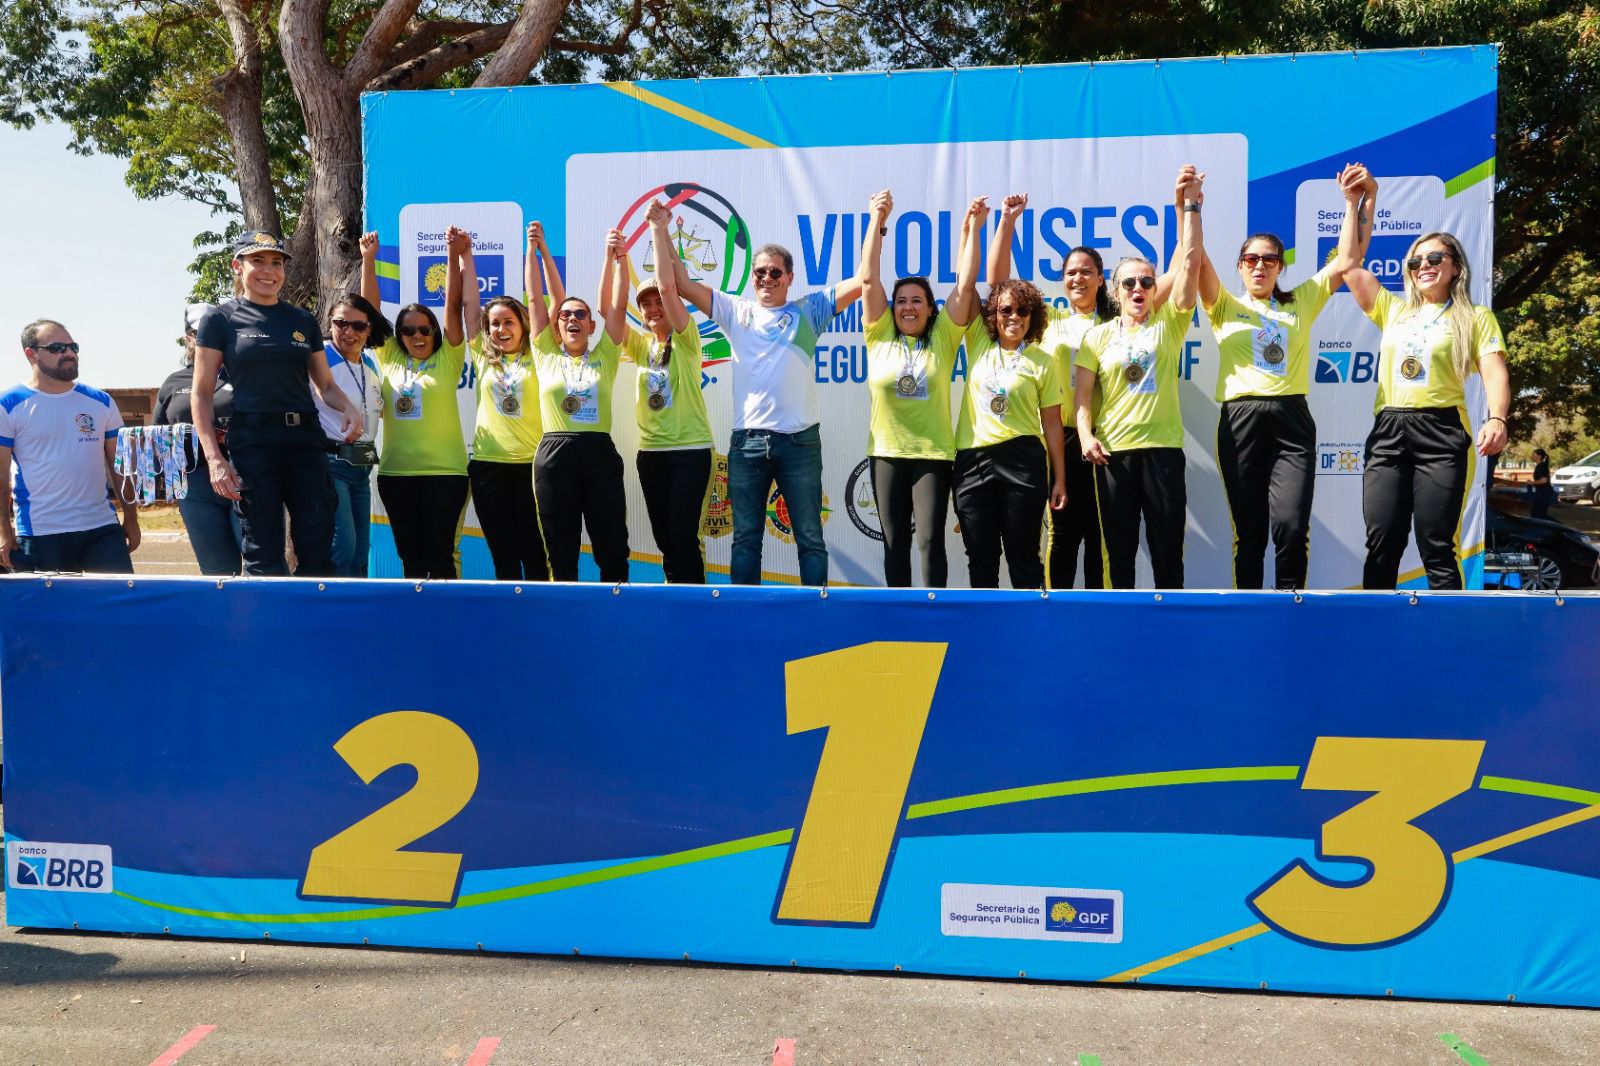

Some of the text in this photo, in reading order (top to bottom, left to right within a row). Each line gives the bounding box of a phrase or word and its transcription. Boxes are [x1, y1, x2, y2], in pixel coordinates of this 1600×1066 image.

[1377, 209, 1391, 218] de
[1380, 220, 1422, 230] Pública
[1318, 340, 1352, 349] banco
[1321, 453, 1337, 469] DF
[776, 640, 949, 926] 1
[300, 710, 479, 904] 2
[1250, 735, 1487, 947] 3
[19, 846, 47, 855] banco
[46, 858, 104, 889] BRB
[976, 903, 1040, 915] Secretaria de
[949, 912, 1040, 925] Segurança Pública
[1078, 912, 1109, 925] GDF
